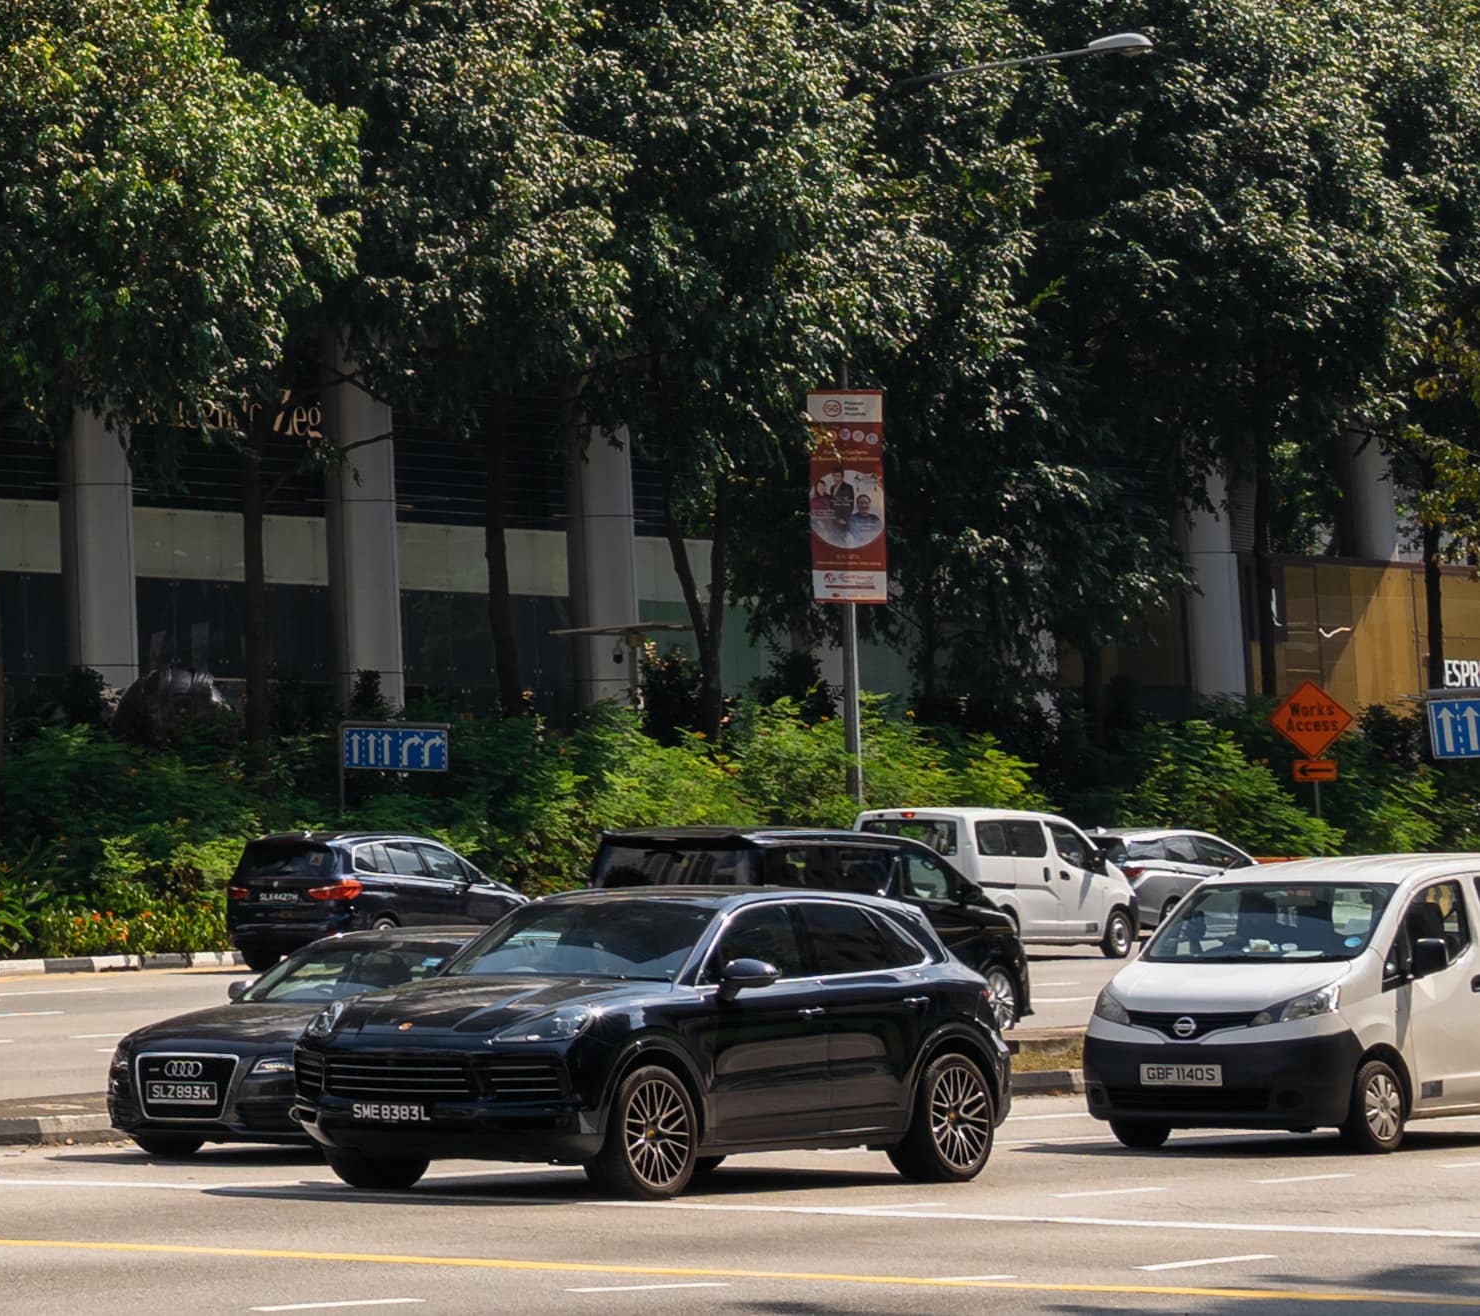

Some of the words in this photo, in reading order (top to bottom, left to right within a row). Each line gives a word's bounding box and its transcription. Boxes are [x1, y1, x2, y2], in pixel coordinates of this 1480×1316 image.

[1289, 703, 1335, 717] Works
[1285, 718, 1339, 732] Access
[1147, 1068, 1215, 1080] GBF1140S
[152, 1085, 210, 1099] SLZ893K
[353, 1103, 431, 1121] SME8383L
